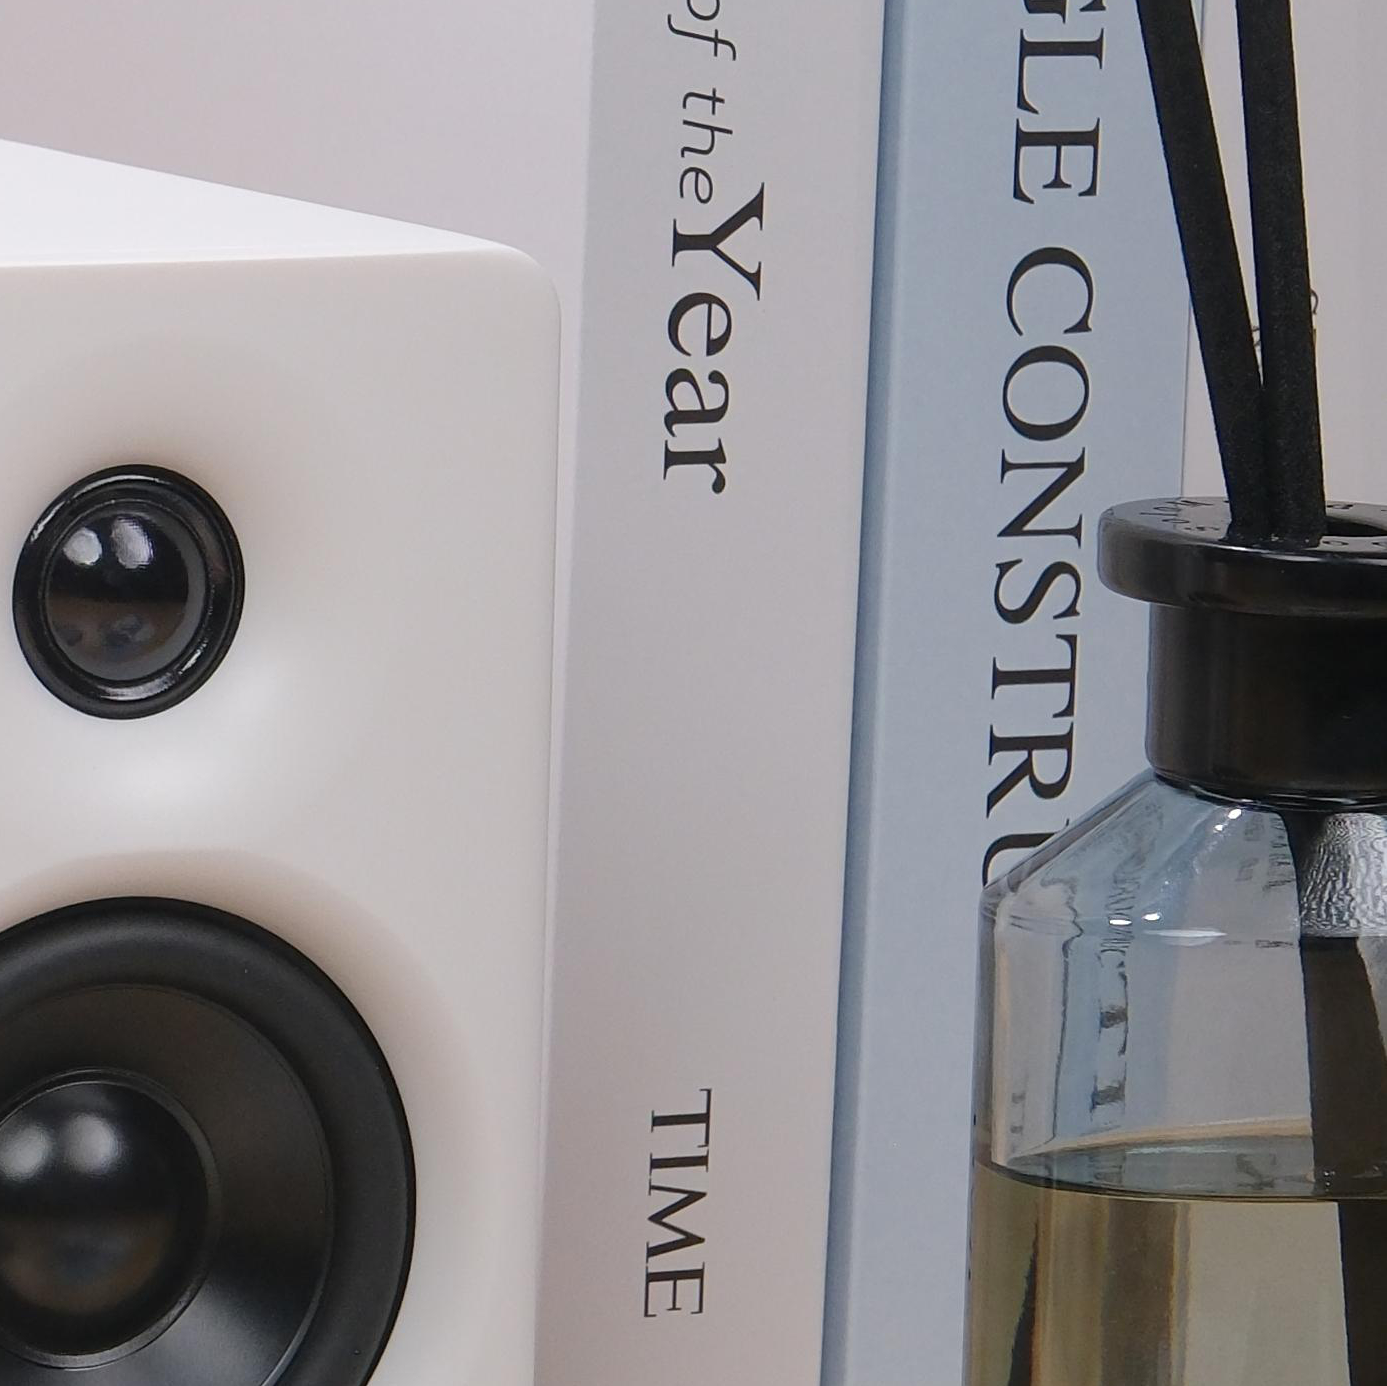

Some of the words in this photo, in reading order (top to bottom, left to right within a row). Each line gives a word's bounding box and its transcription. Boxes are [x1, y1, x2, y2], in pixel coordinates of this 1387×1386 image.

[678, 88, 734, 205] the
[662, 182, 765, 495] Year
[644, 1088, 712, 1318] TIME
